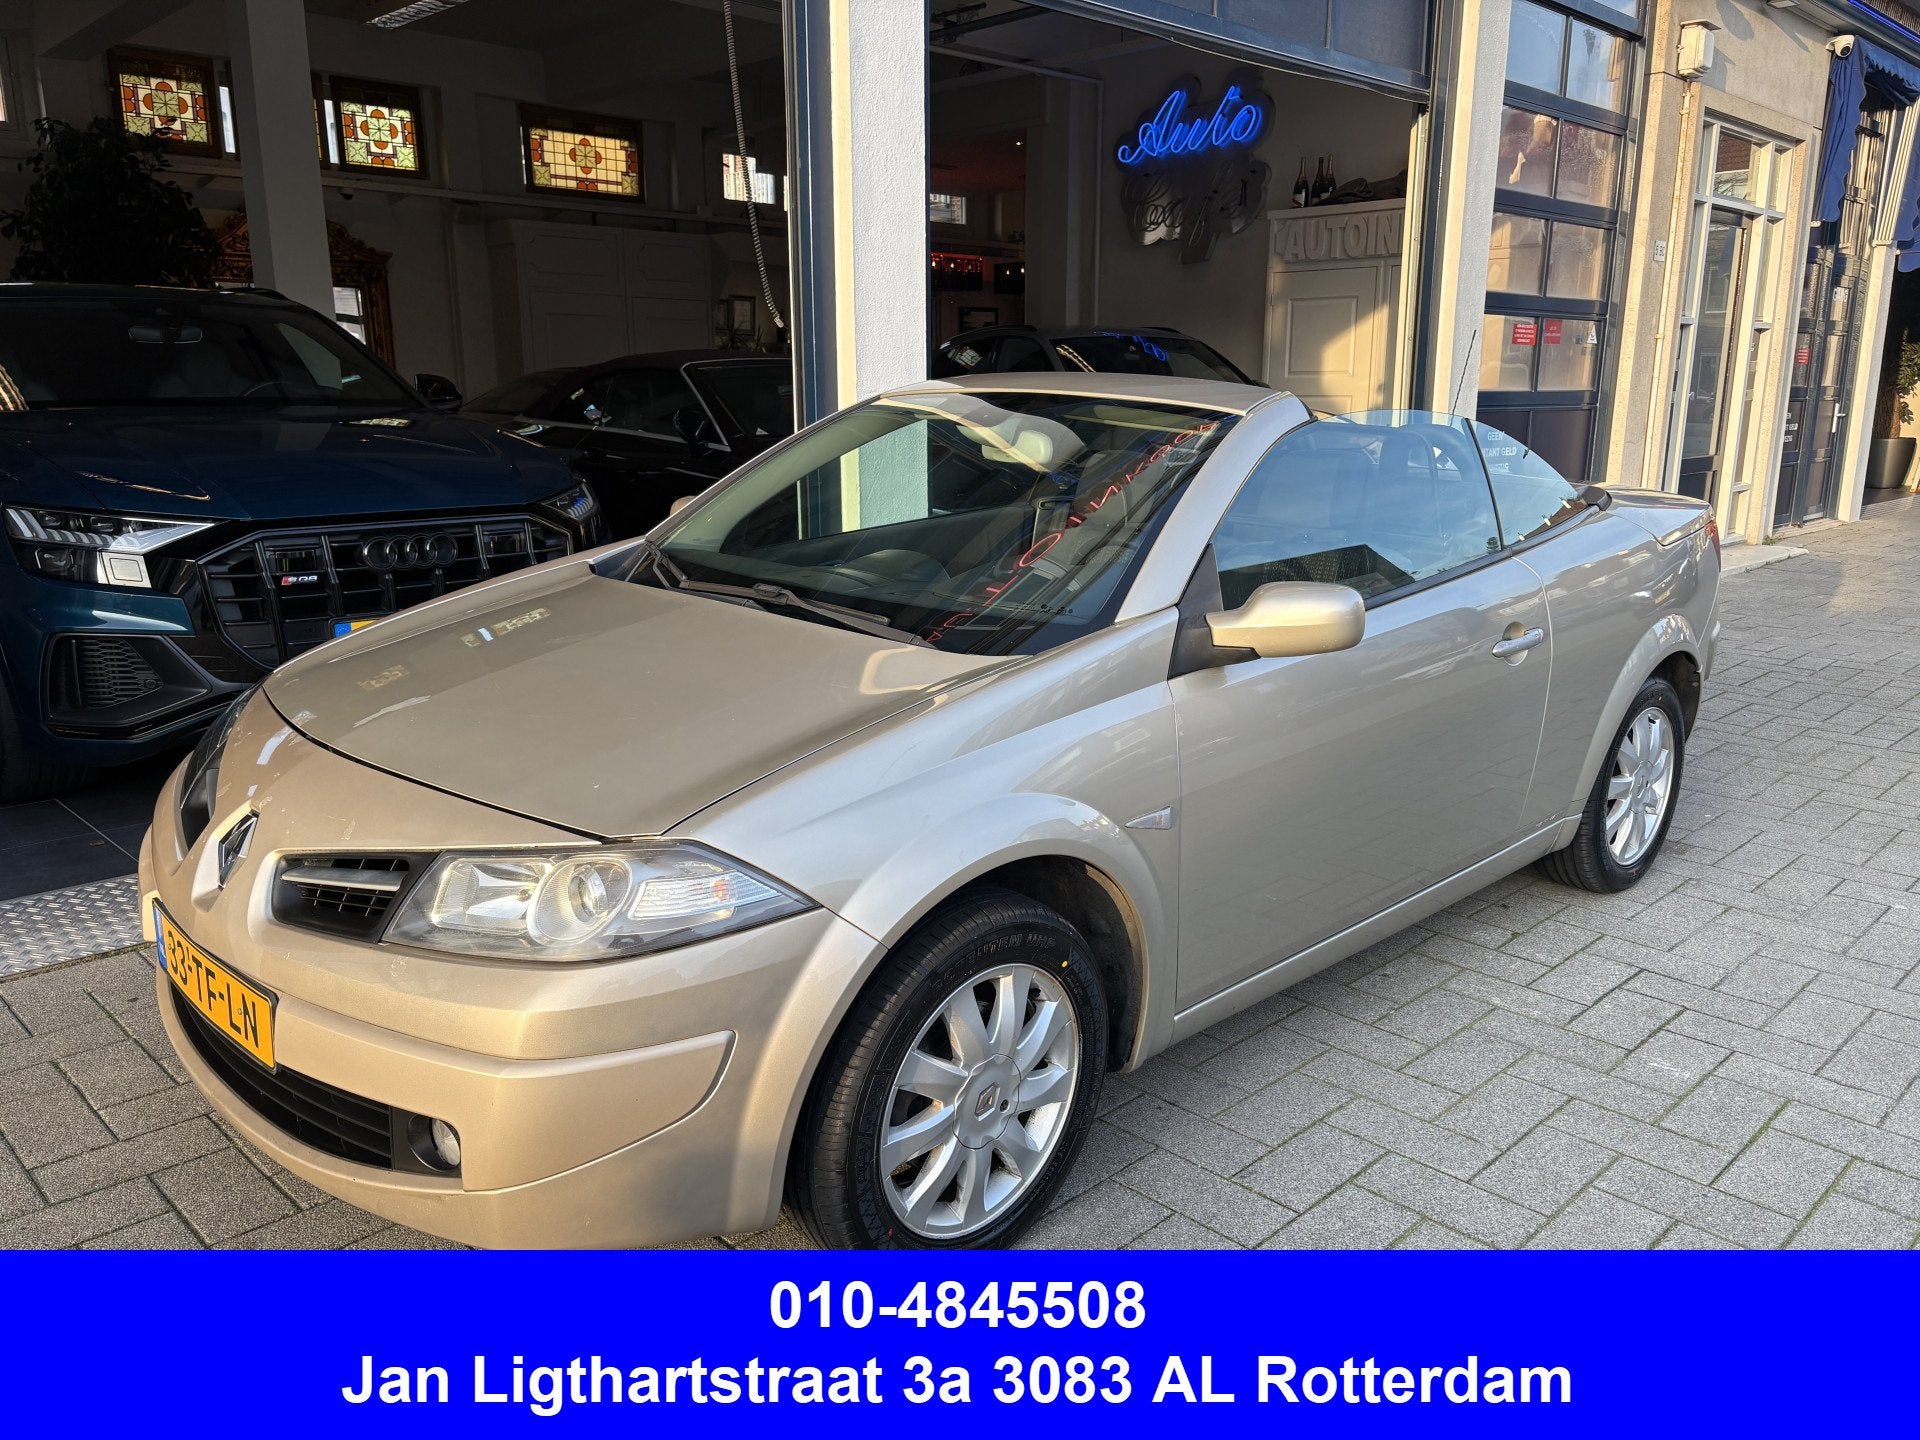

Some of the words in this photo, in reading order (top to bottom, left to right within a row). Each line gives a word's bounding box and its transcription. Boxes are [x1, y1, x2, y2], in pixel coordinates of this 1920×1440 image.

[1117, 85, 1262, 164] Auto
[1501, 446, 1517, 456] GELD
[168, 929, 259, 1049] 33-TF-LN
